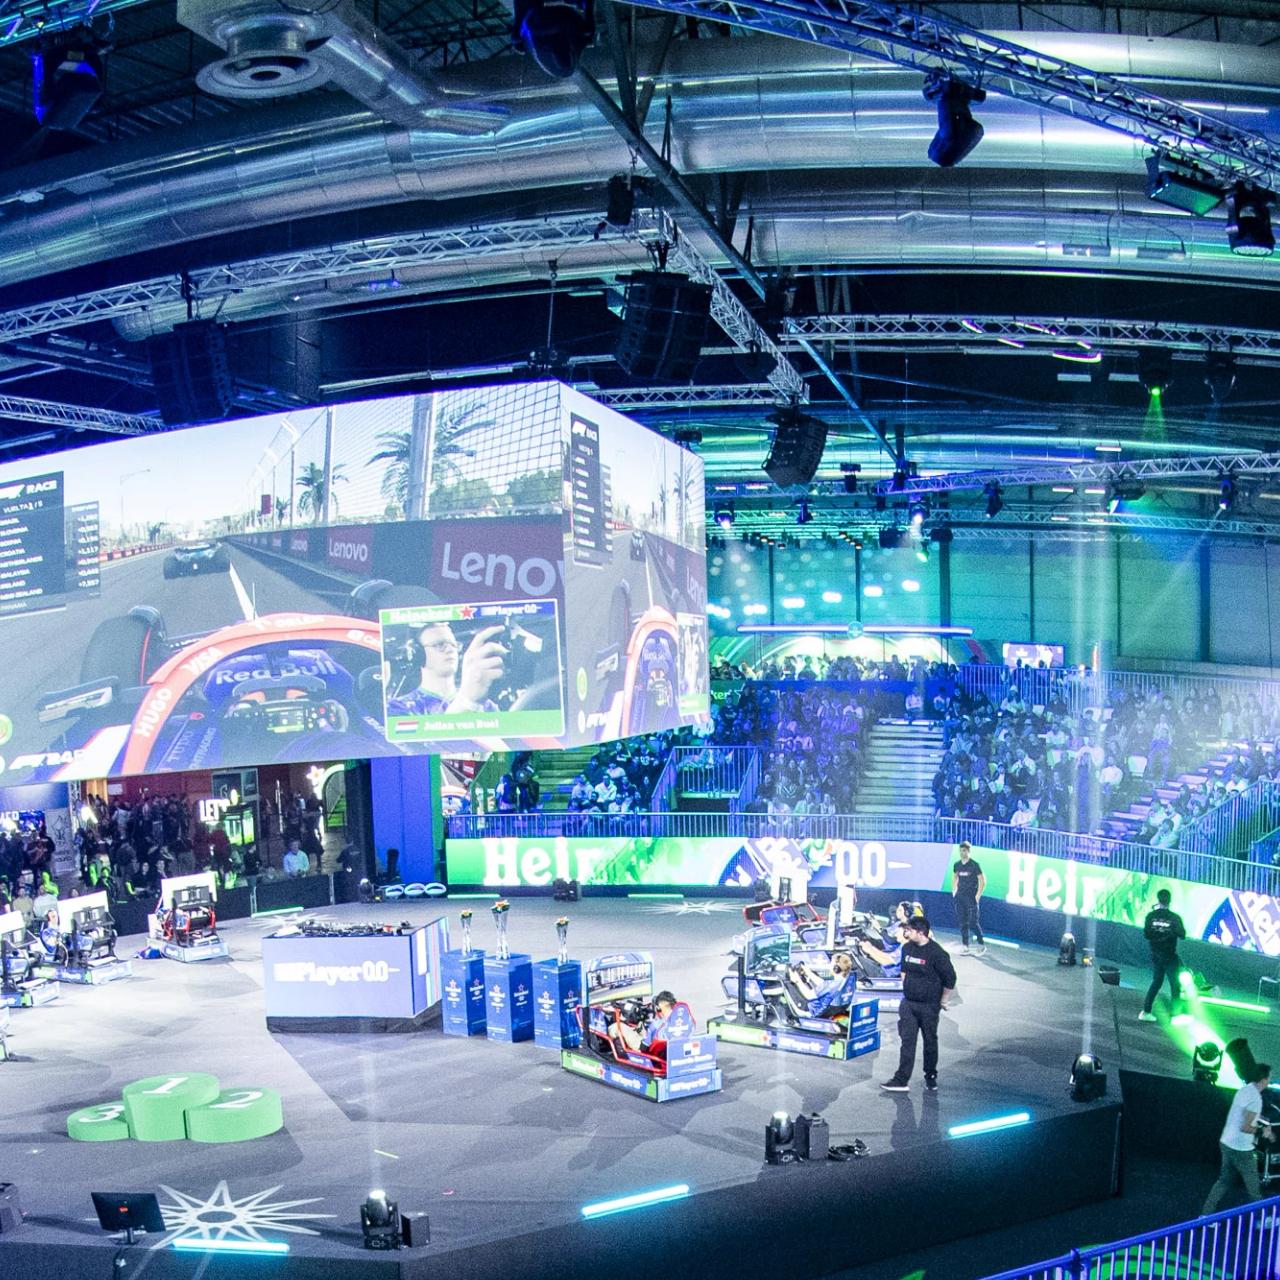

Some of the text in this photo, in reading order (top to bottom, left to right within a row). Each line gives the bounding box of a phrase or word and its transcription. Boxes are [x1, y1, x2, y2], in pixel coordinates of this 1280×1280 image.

[26, 480, 57, 494] RACE
[328, 538, 369, 562] Lenovo
[182, 647, 223, 676] VISA
[216, 660, 337, 685] Red Bull
[134, 687, 172, 737] HUGO
[142, 1077, 188, 1094] 1
[209, 1091, 263, 1109] 2
[78, 1104, 125, 1122] 3
